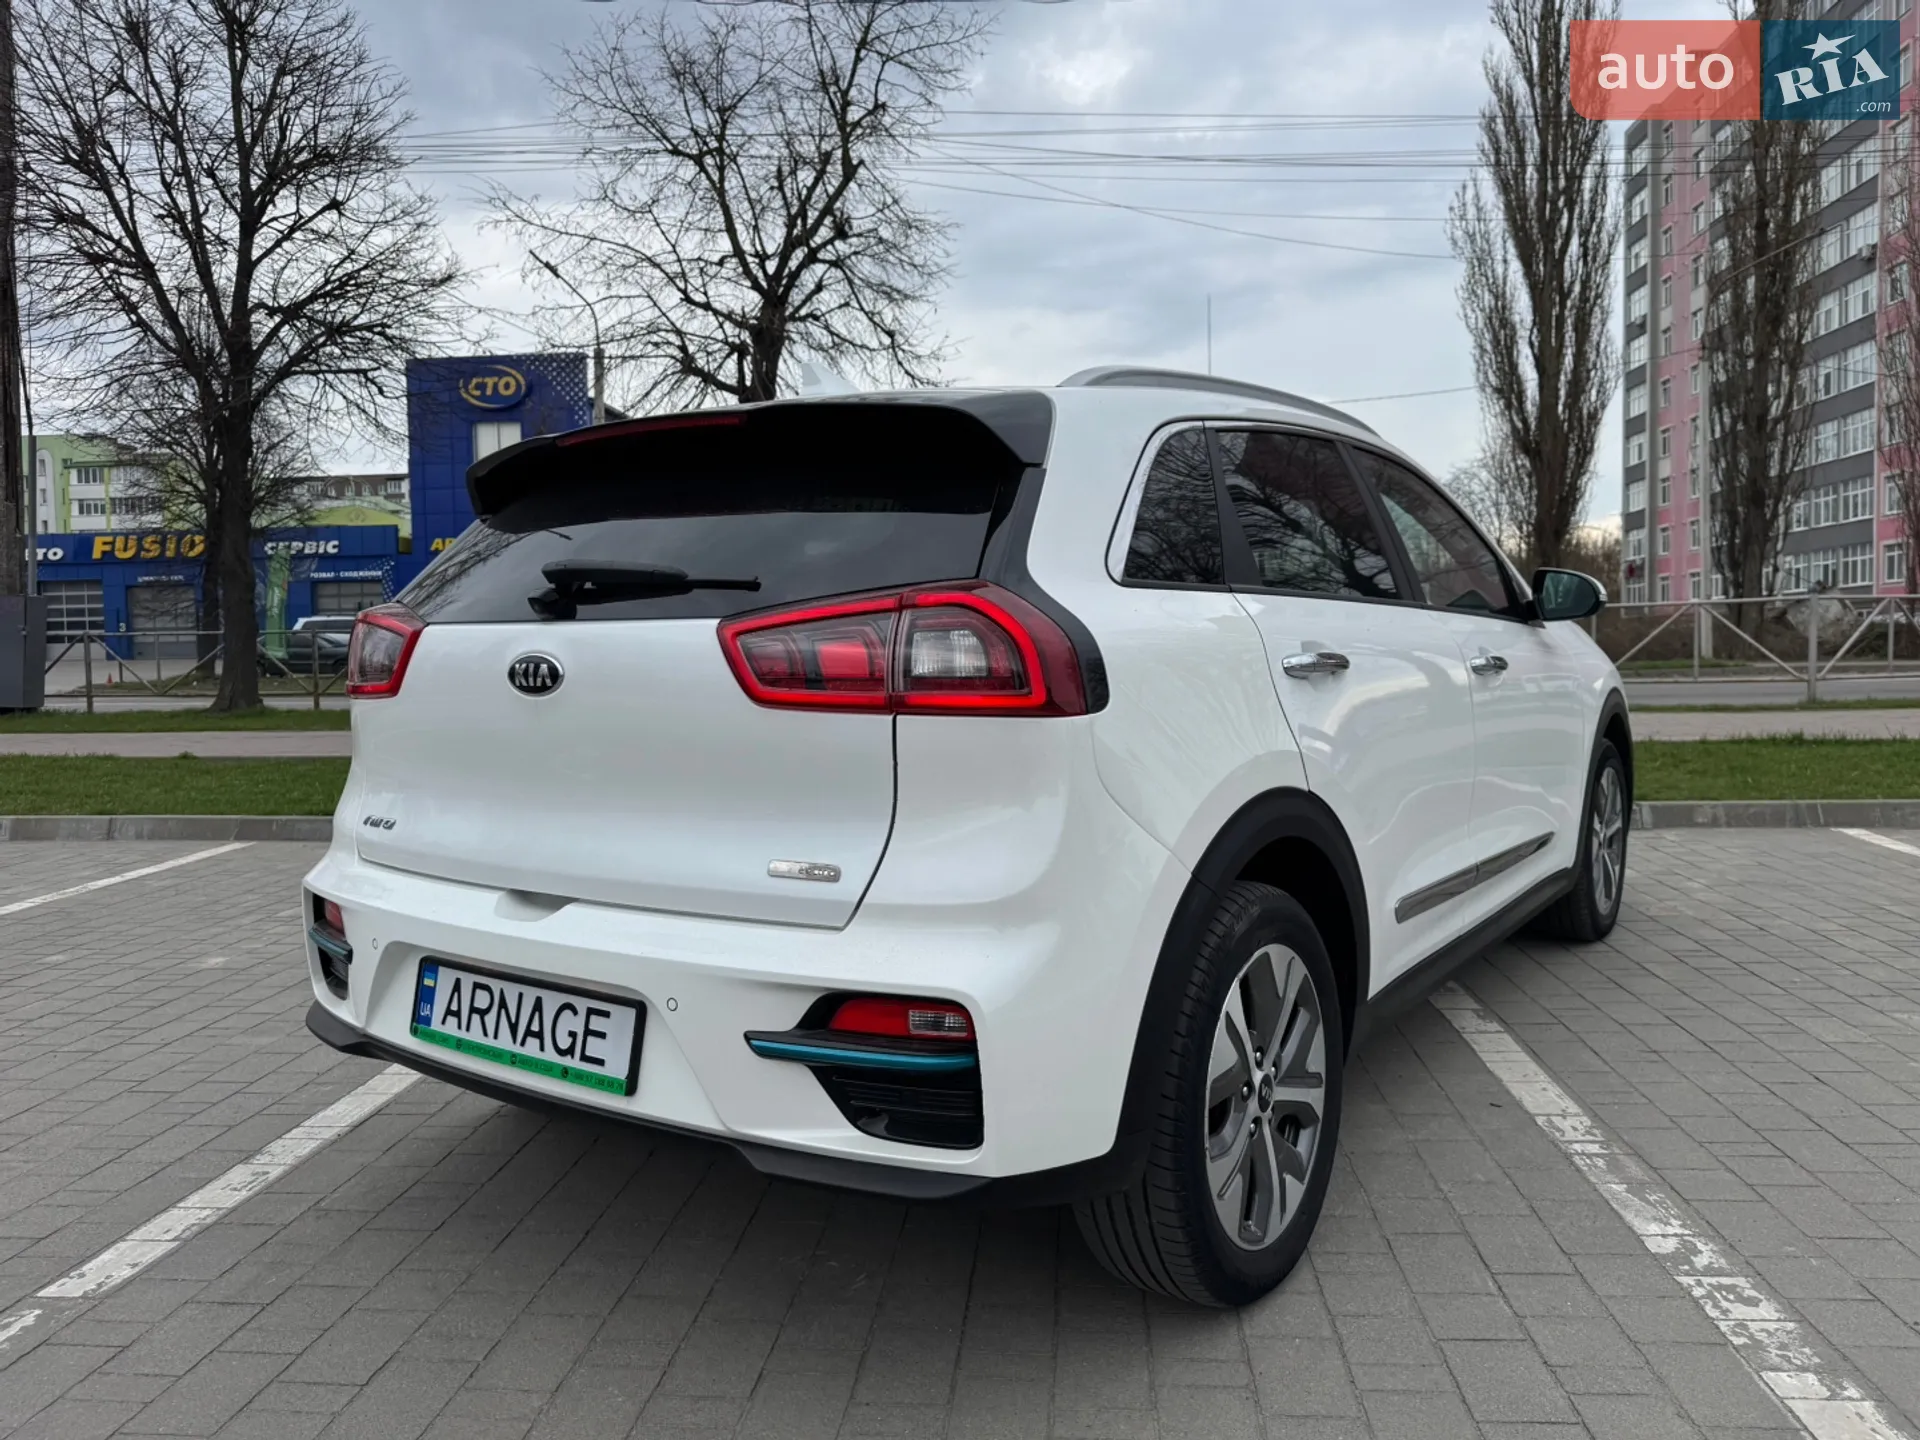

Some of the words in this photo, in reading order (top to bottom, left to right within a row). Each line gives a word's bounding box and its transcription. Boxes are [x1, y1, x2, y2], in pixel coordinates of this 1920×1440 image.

[468, 376, 518, 397] СТО
[25, 547, 64, 561] ТО
[91, 534, 206, 560] FUSIO
[514, 662, 553, 687] KIA
[441, 977, 611, 1067] ARNAGE
